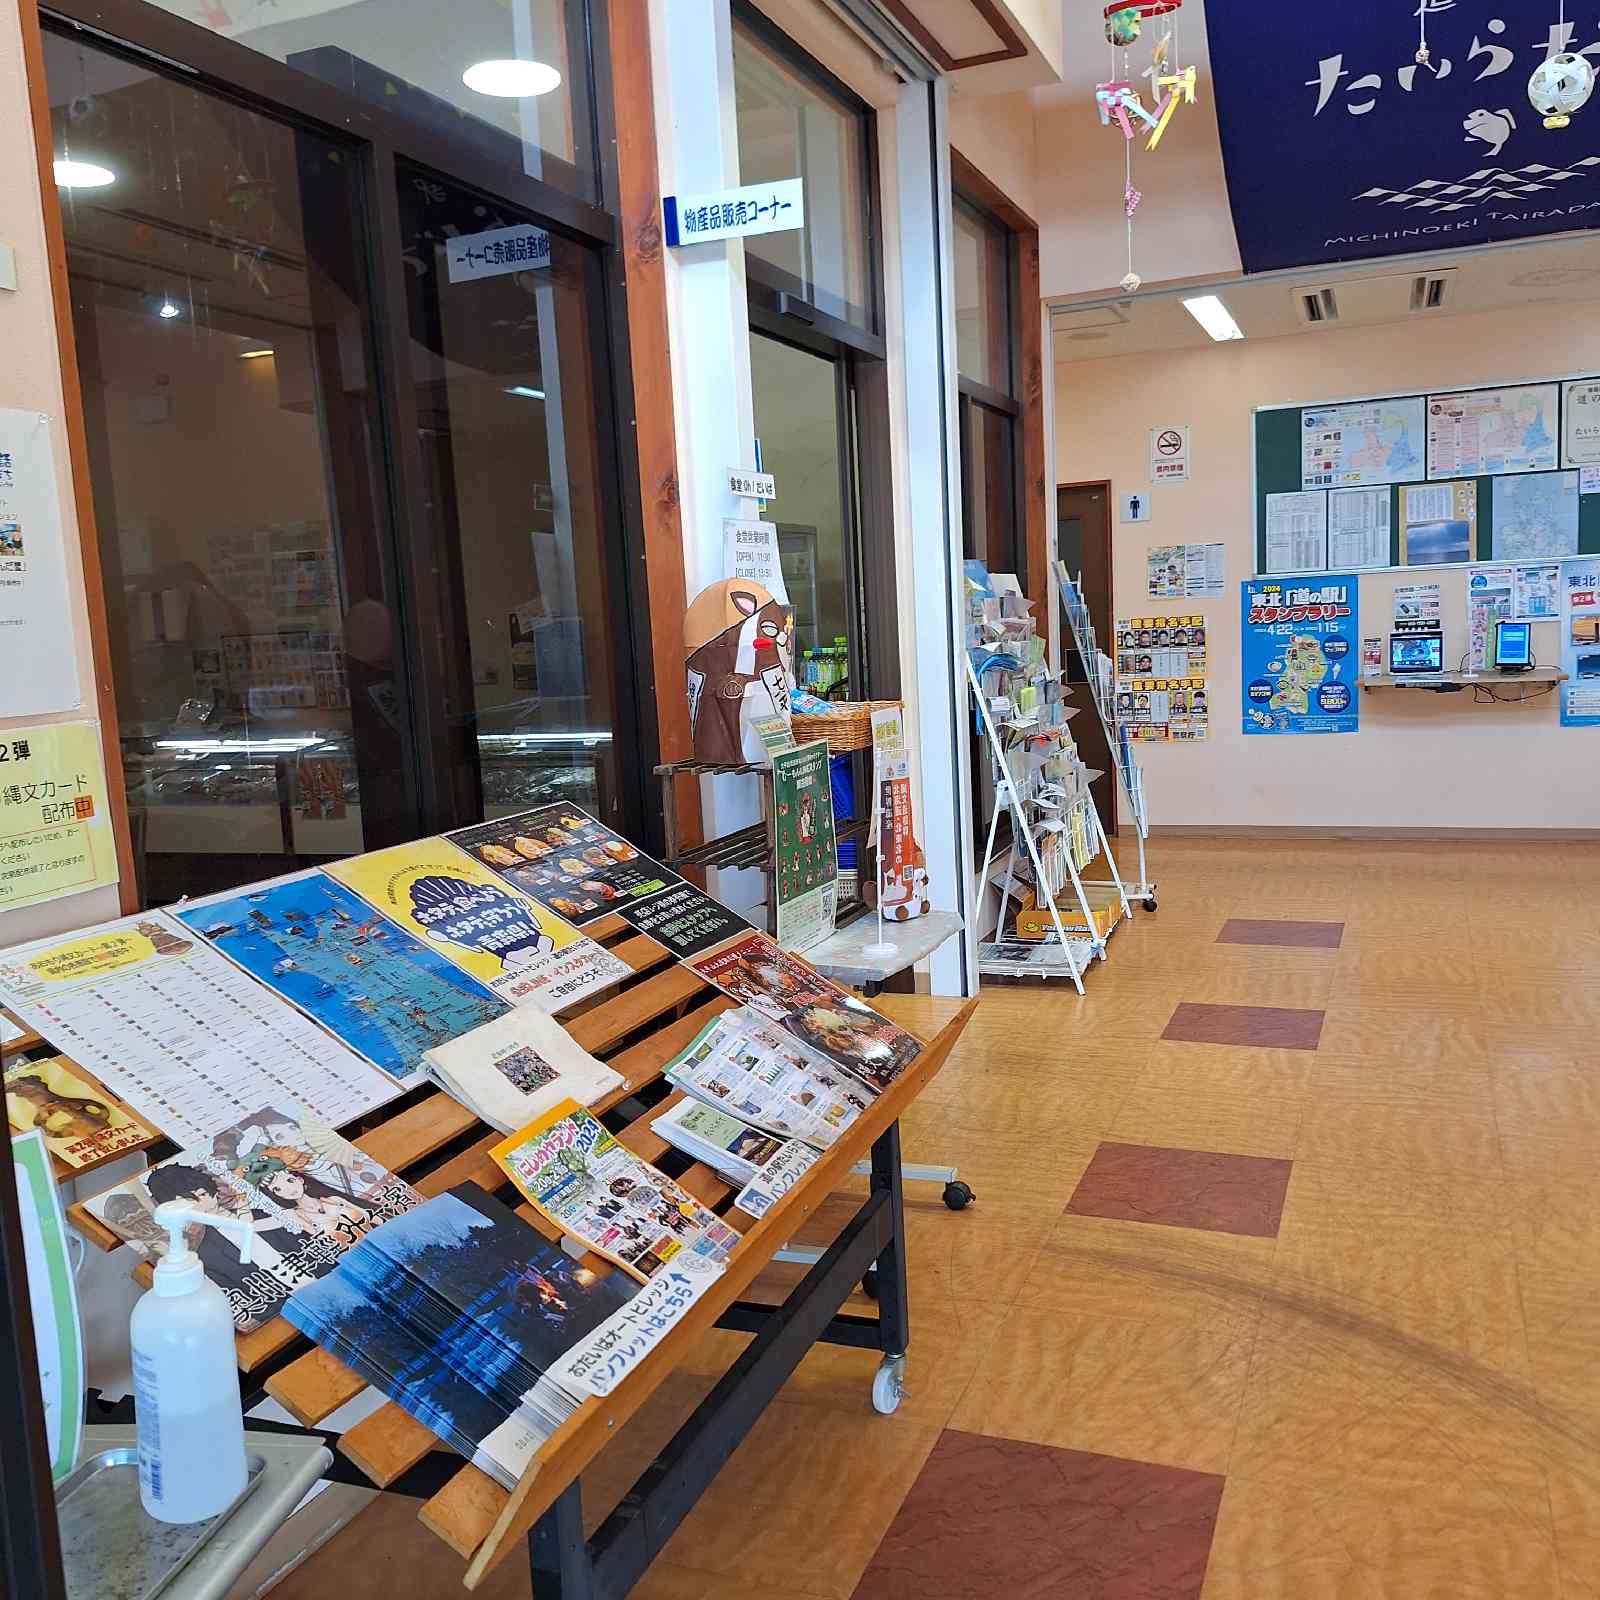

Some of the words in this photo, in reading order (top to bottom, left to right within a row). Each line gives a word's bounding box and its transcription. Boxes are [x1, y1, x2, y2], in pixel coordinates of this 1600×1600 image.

[684, 195, 792, 234] 物産品販売コーナー
[1324, 217, 1479, 247] MICHINOEKI
[1568, 575, 1600, 588] 東北
[1248, 603, 1351, 624] スタンプラリー
[2, 774, 88, 806] 縄文カード
[41, 797, 95, 824] 配布中
[548, 967, 604, 998] ご自由にどうぞ
[576, 1118, 602, 1154] 2024
[590, 1287, 694, 1393] パンフレットはこちら
